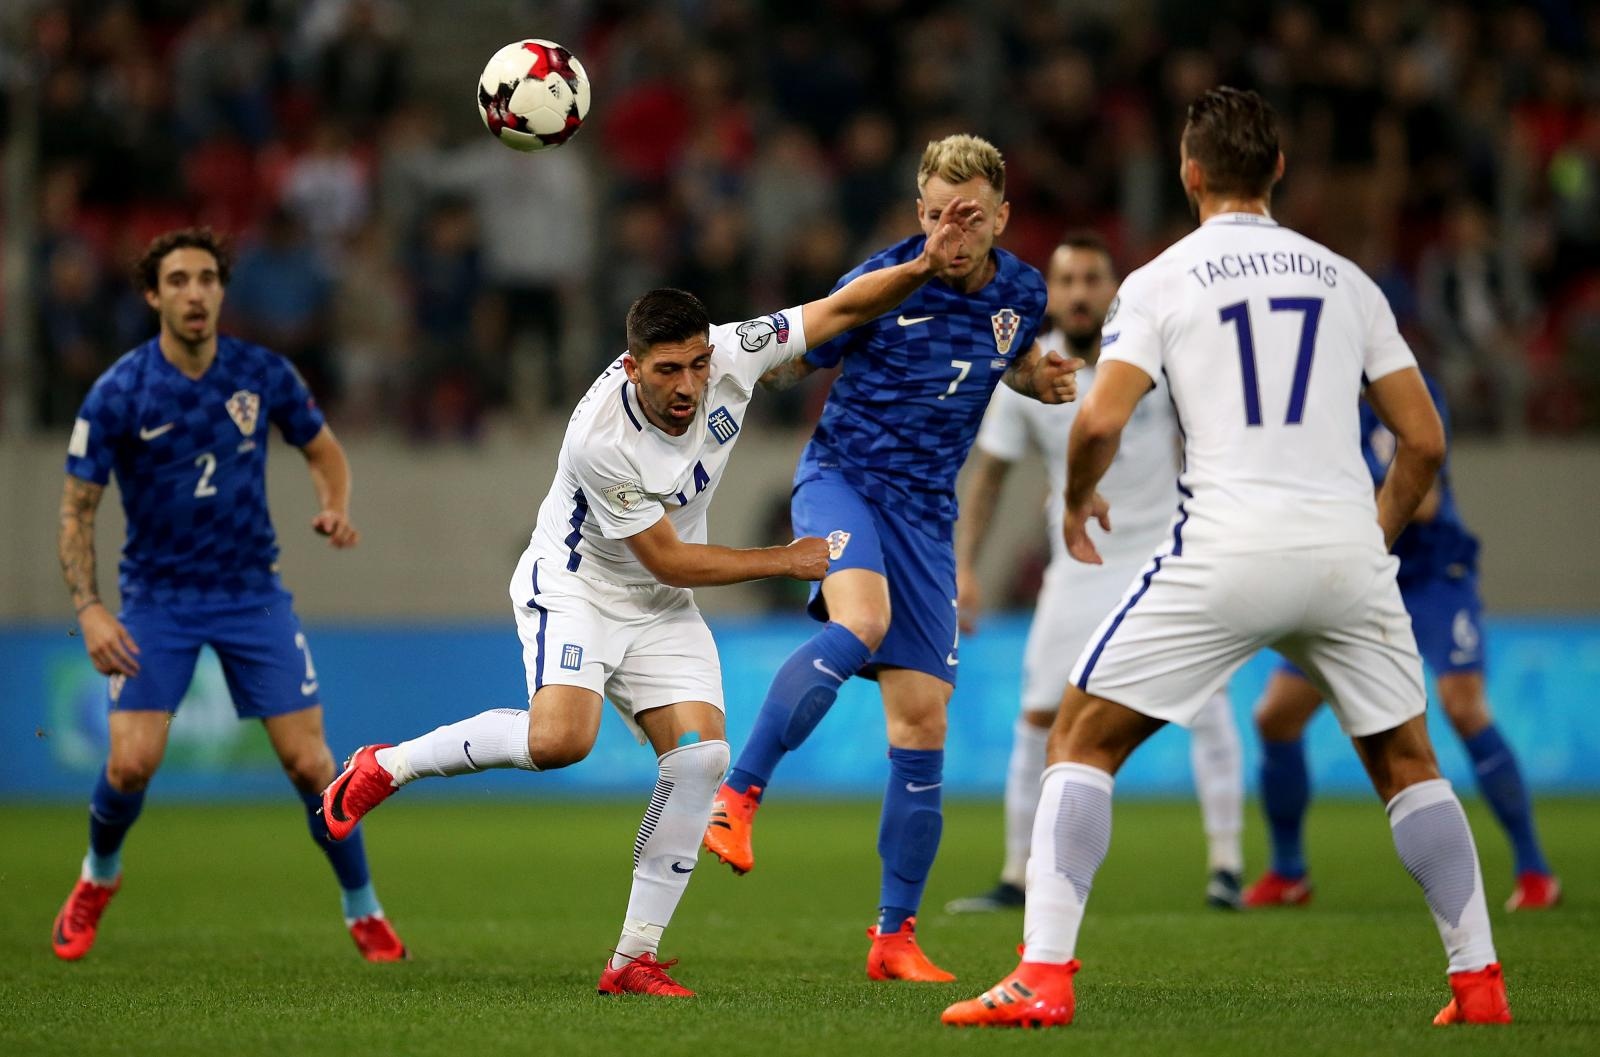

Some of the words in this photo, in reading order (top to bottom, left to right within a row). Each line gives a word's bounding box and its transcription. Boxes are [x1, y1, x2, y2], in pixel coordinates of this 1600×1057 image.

[1188, 252, 1338, 289] TACHTSIDIS
[937, 359, 973, 401] 7
[1218, 296, 1325, 428] 17
[194, 453, 218, 498] 2
